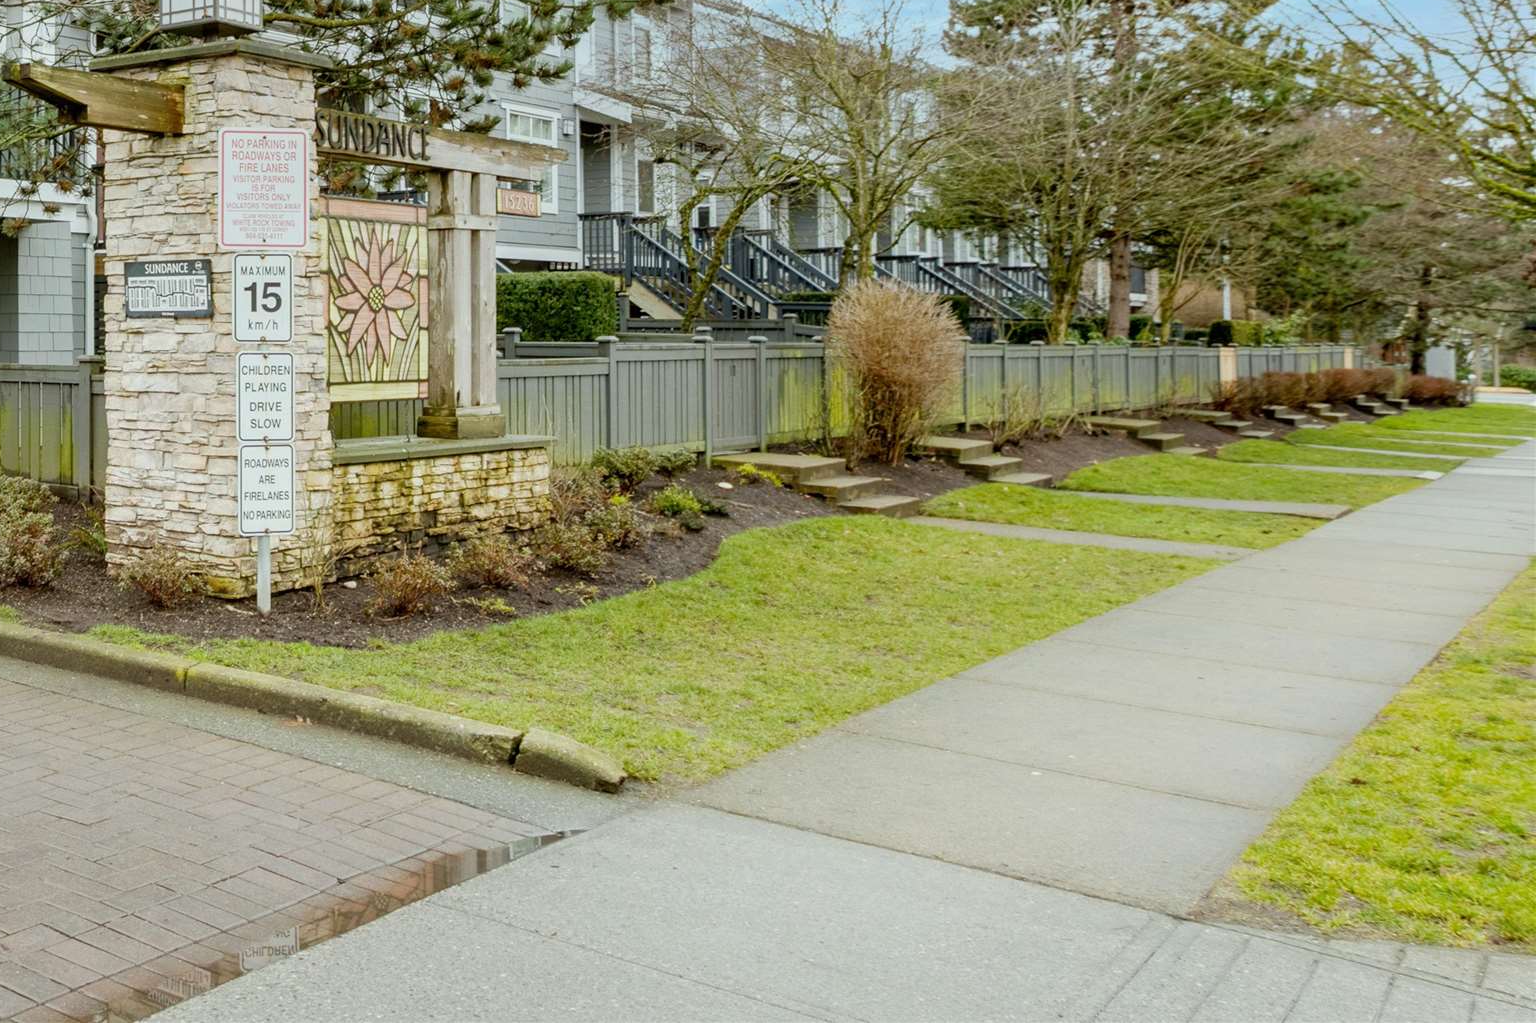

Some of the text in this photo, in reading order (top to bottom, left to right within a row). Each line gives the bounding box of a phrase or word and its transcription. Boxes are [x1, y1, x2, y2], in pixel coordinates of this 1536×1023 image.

[314, 109, 432, 161] SUNDANCE
[232, 139, 297, 149] NO PARKING IN
[232, 152, 296, 161] ROADWAYS OR
[240, 163, 289, 173] FIRE LANES
[252, 184, 276, 192] IS FOR
[237, 193, 291, 201] VISITORS ONLY
[505, 194, 534, 211] 15236
[144, 263, 189, 274] SUNDANCE
[240, 266, 286, 275] MAXIMUM
[244, 282, 282, 313] 15
[248, 320, 279, 330] km/h
[242, 365, 290, 375] CHILDREN
[245, 382, 287, 392] PLAYING
[250, 402, 283, 412] DRIVE
[250, 419, 281, 429] SLOW
[244, 458, 289, 468] ROADWAYS
[259, 475, 276, 484] ARE
[244, 491, 290, 501] FIRELANES
[243, 510, 291, 520] NO PARKING
